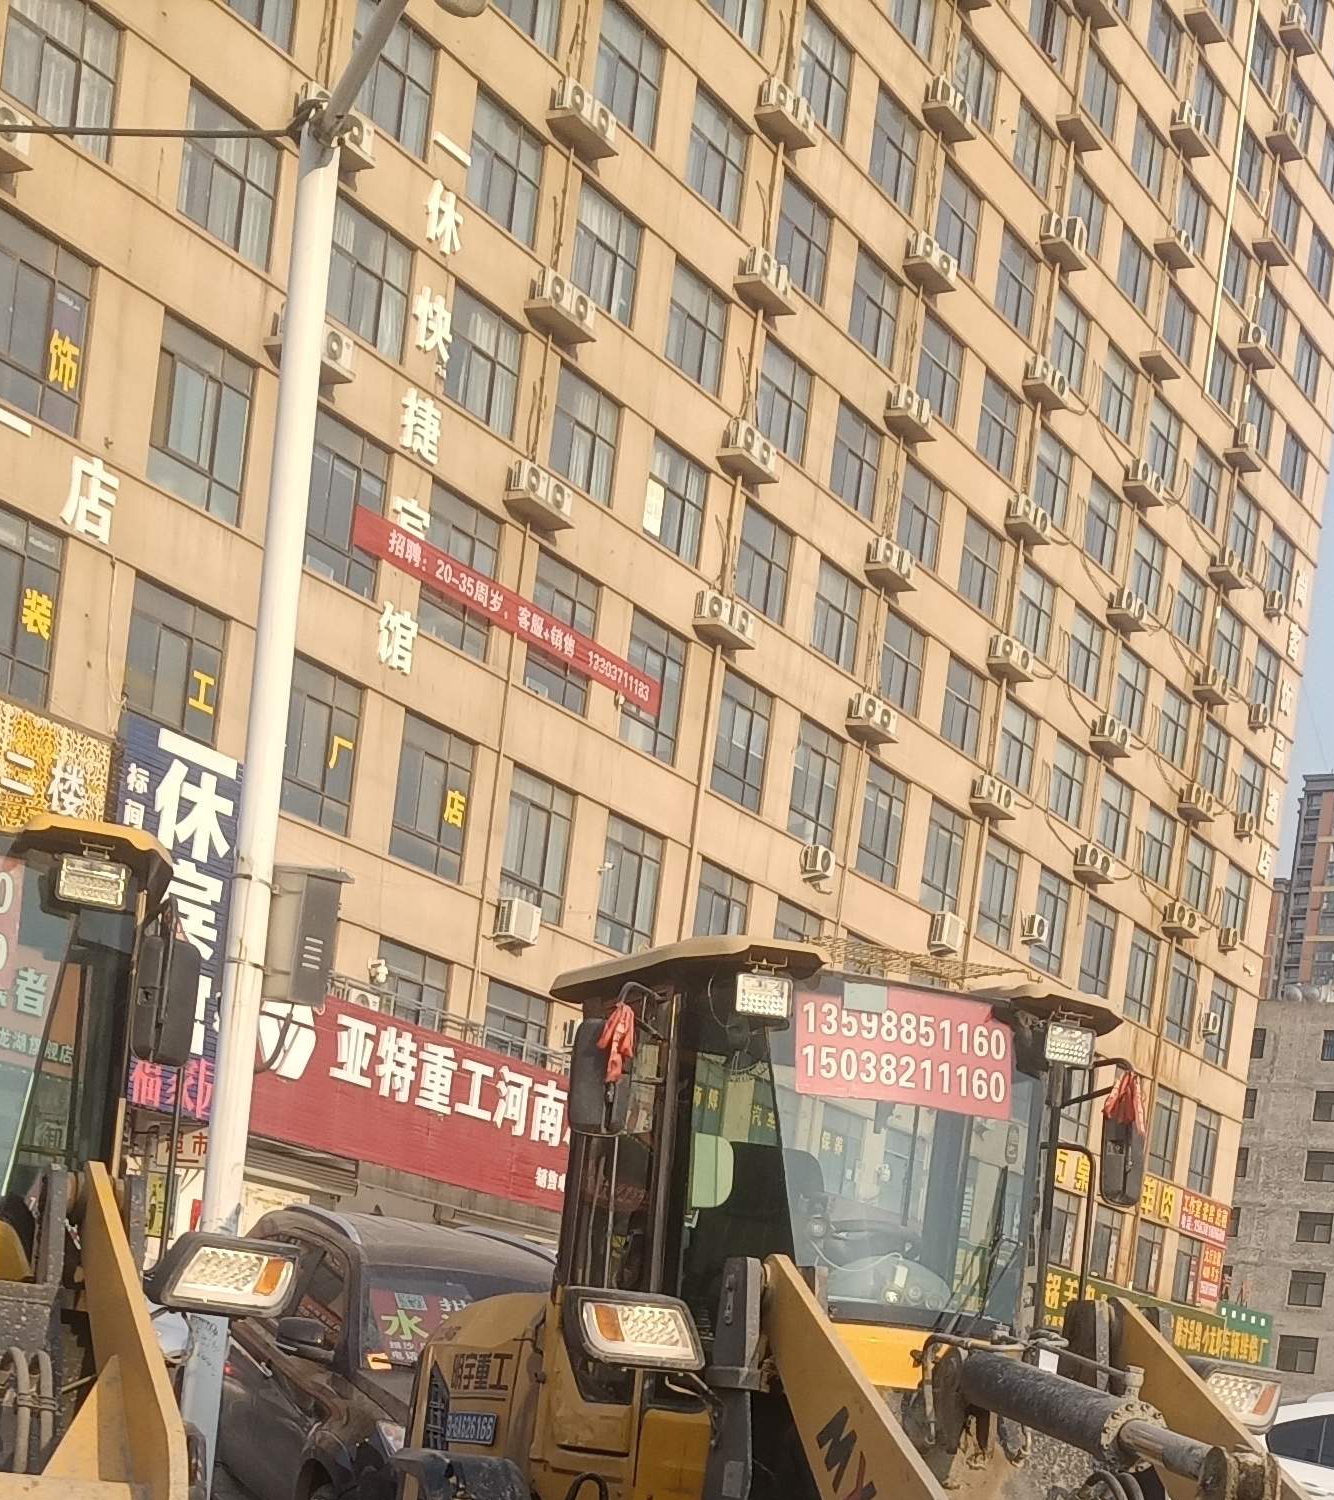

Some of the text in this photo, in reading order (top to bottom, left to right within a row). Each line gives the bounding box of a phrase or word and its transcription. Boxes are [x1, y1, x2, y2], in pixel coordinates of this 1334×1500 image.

[48, 329, 80, 393] 饰
[802, 1001, 1006, 1061] 13598851160
[329, 1013, 570, 1147] 亚特重工河南
[802, 1045, 1006, 1103] 15038211160
